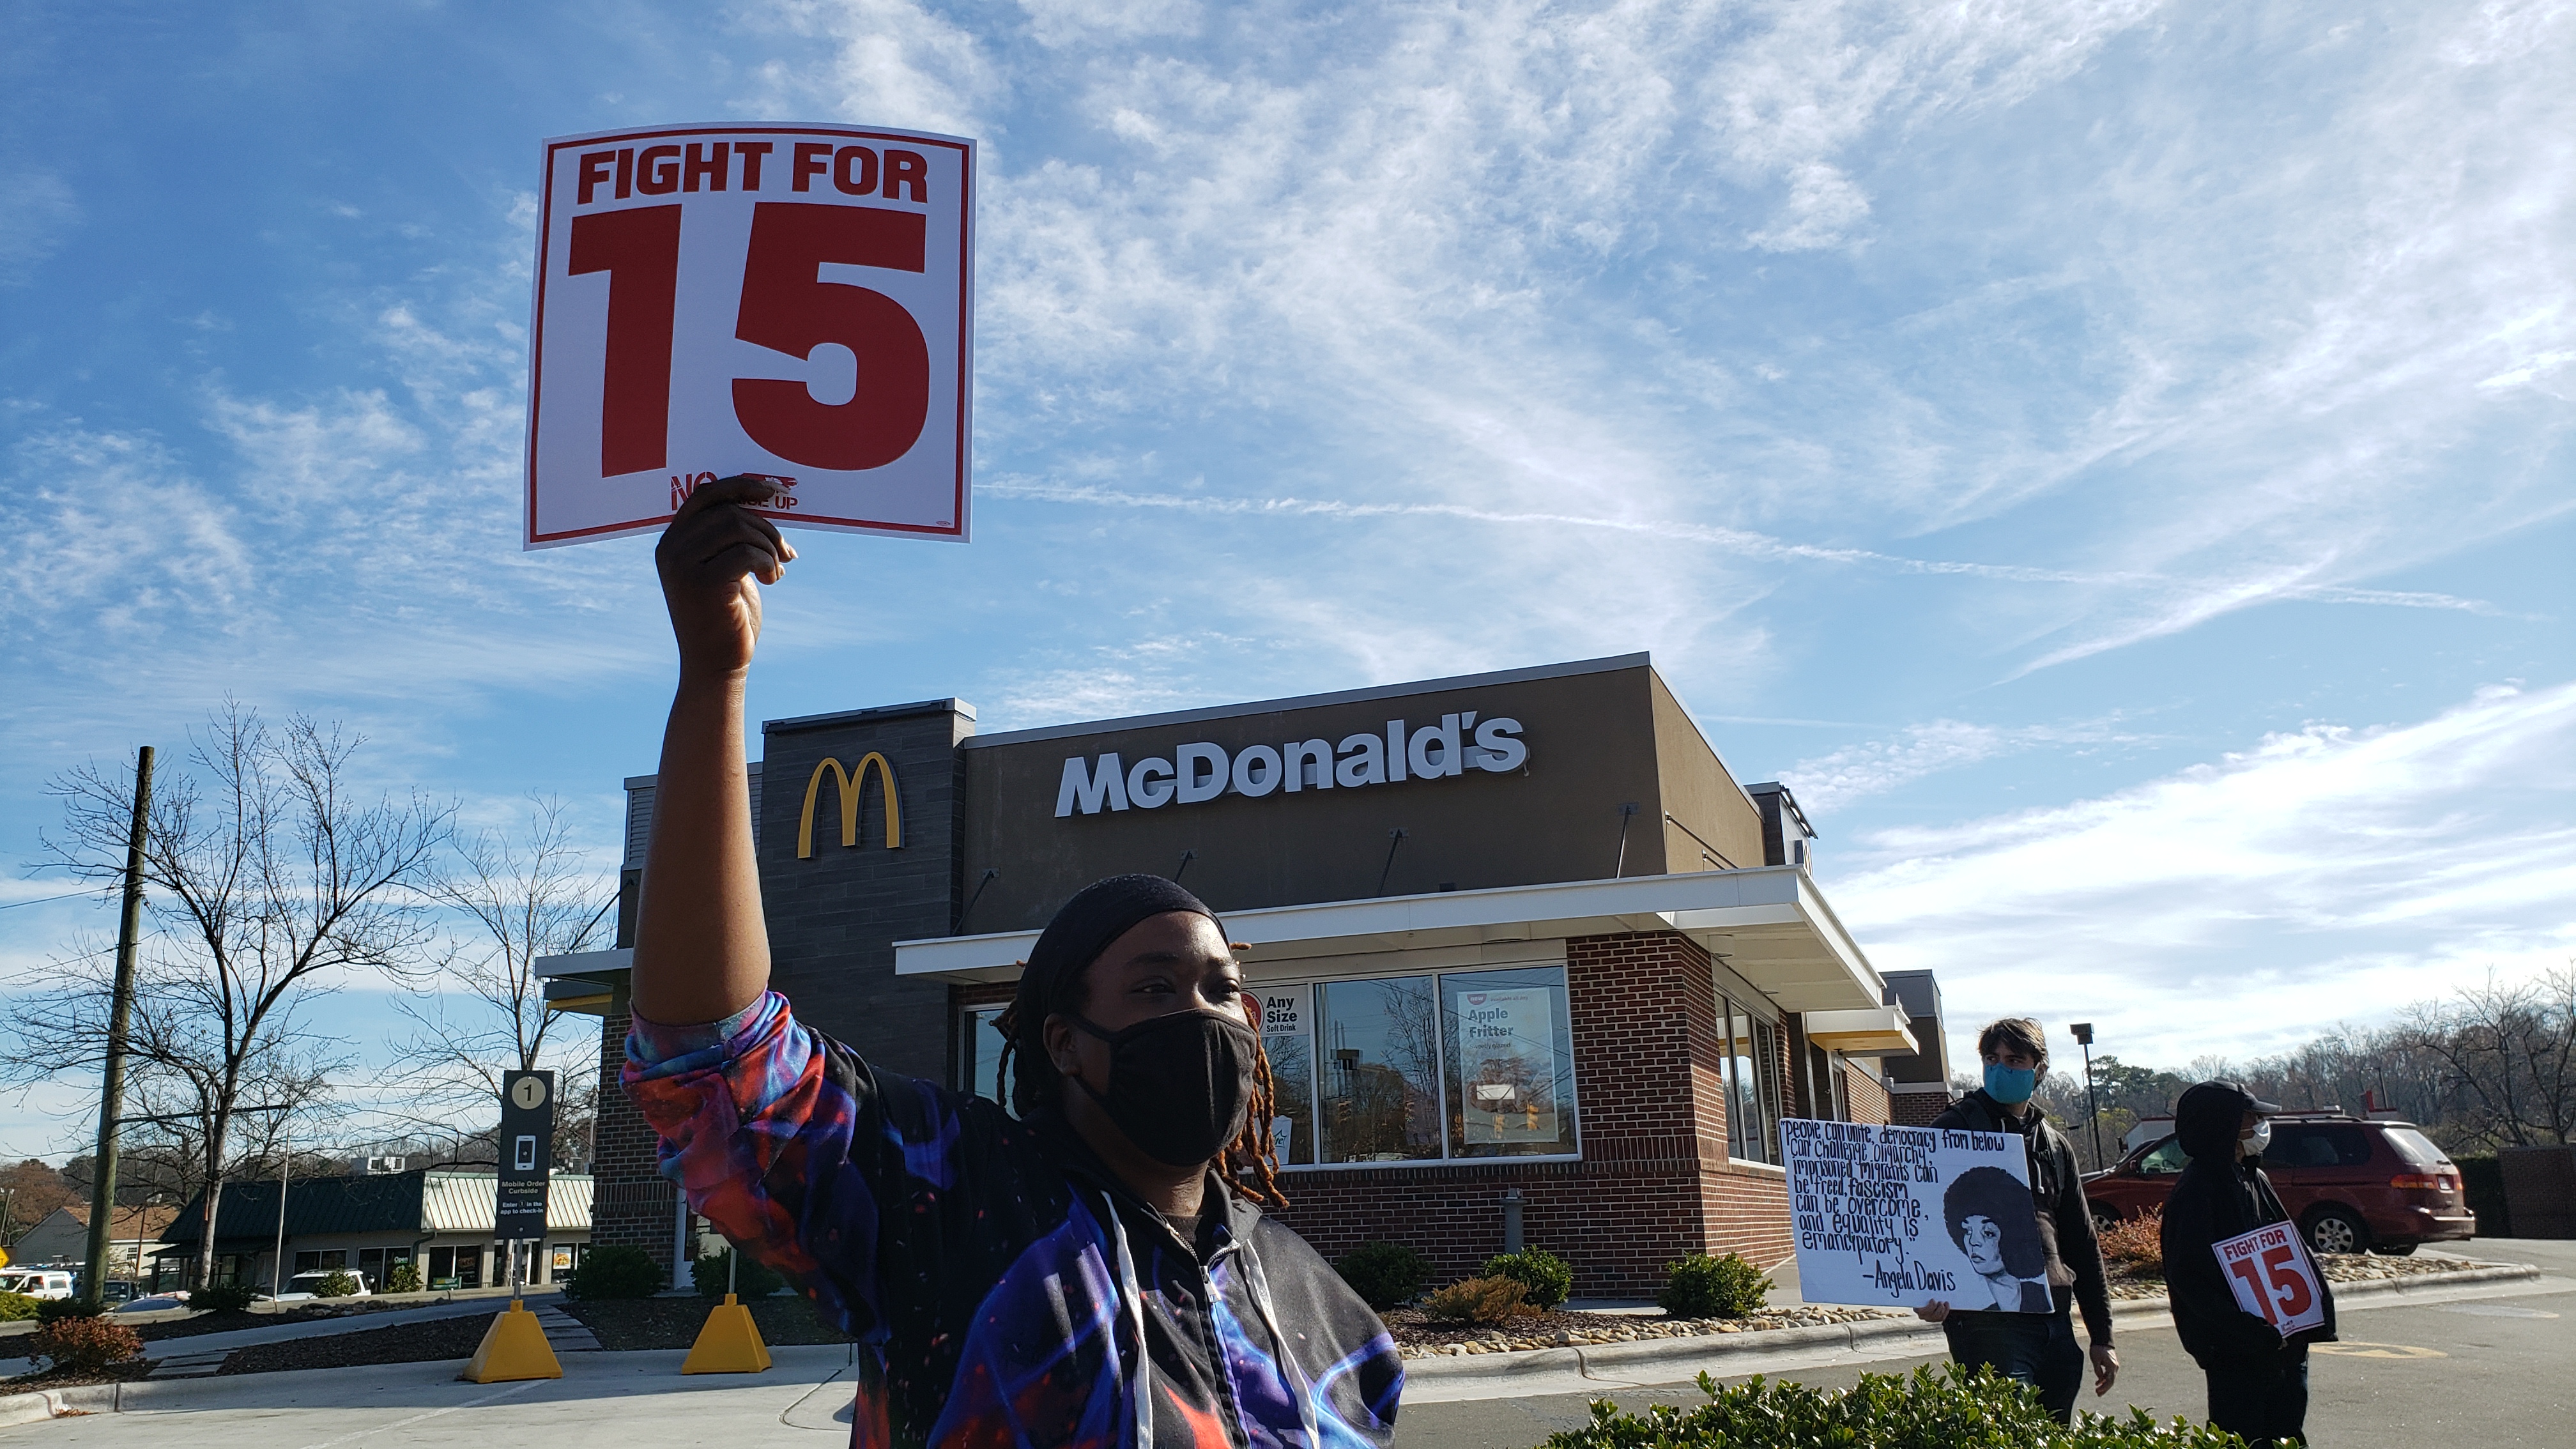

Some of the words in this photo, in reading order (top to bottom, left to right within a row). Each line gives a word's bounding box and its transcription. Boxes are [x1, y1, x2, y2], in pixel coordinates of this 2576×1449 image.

[578, 142, 773, 205] FIGHT
[792, 142, 928, 204] FOR
[568, 201, 930, 478] 15
[775, 496, 798, 510] UP
[1054, 710, 1527, 818] McDonald's
[1266, 997, 1294, 1011] Any
[1266, 1009, 1298, 1023] Size
[1469, 1008, 1508, 1023] Apple
[1280, 1023, 1296, 1032] Drink
[1469, 1024, 1514, 1038] Fritter
[523, 1084, 532, 1101] 1
[1825, 1122, 1845, 1142] can
[1846, 1123, 1874, 1145] unite,
[1879, 1124, 1936, 1153] democracy
[1942, 1128, 1969, 1150] from
[1970, 1130, 2005, 1152] below
[1790, 1138, 1811, 1158] can
[1873, 1144, 1933, 1167] oligarchy,
[1791, 1156, 1853, 1184] imprisoned
[1860, 1160, 1910, 1183] migrants
[1913, 1163, 1938, 1183] can
[1793, 1174, 1810, 1194] be
[1814, 1175, 1848, 1197] freed,
[1848, 1177, 1908, 1200] fascism
[1795, 1193, 1820, 1213] can
[1824, 1193, 1839, 1214] be
[1847, 1196, 1929, 1221] overcome,
[1798, 1211, 1825, 1232] and
[1832, 1213, 1894, 1239] equality
[1902, 1216, 1919, 1237] is
[2223, 1237, 2260, 1261] FIGHT
[2258, 1229, 2287, 1248] FOR
[1913, 1260, 1956, 1291] Davis
[2228, 1245, 2312, 1326] 15
